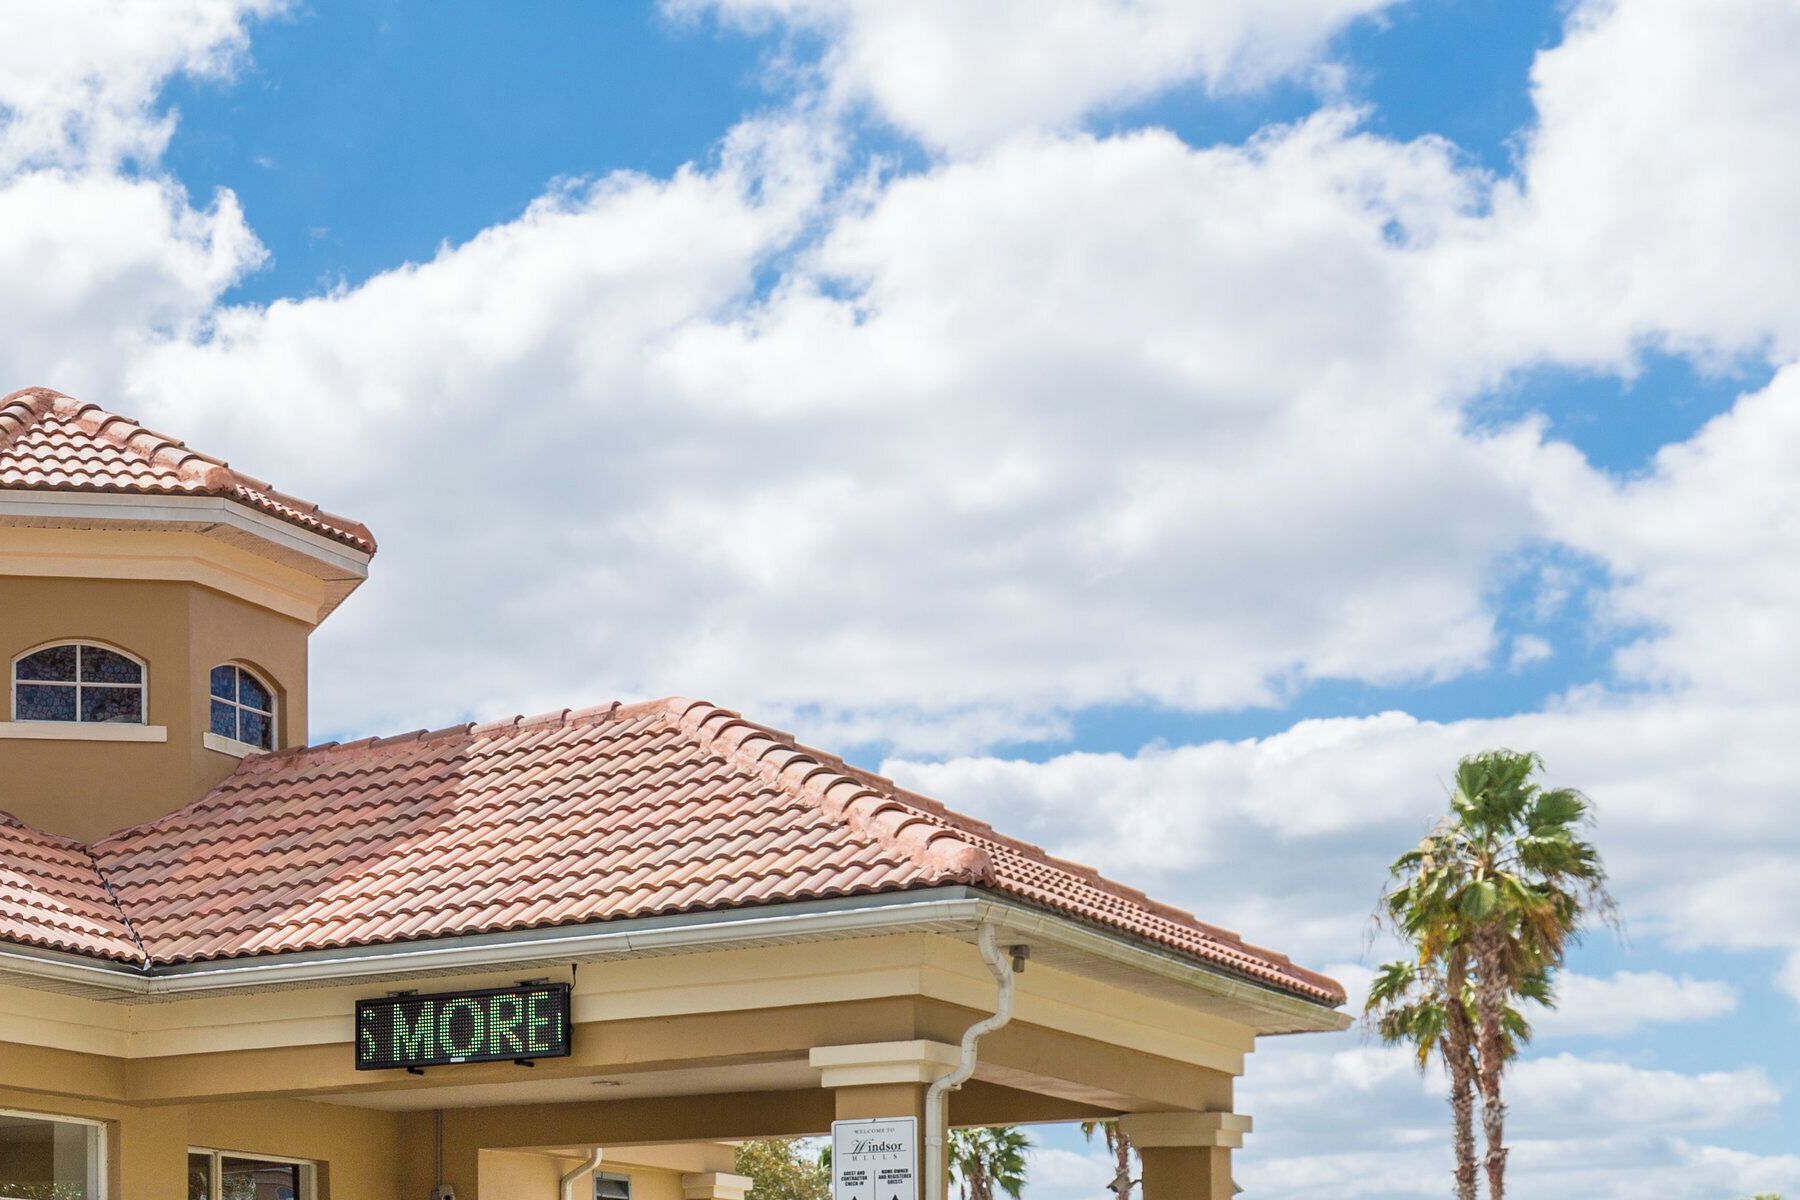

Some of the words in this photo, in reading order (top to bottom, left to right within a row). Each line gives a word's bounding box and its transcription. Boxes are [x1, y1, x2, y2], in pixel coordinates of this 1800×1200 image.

[393, 991, 549, 1061] MORE
[851, 1138, 904, 1154] Windsor
[852, 1153, 898, 1161] HILLS
